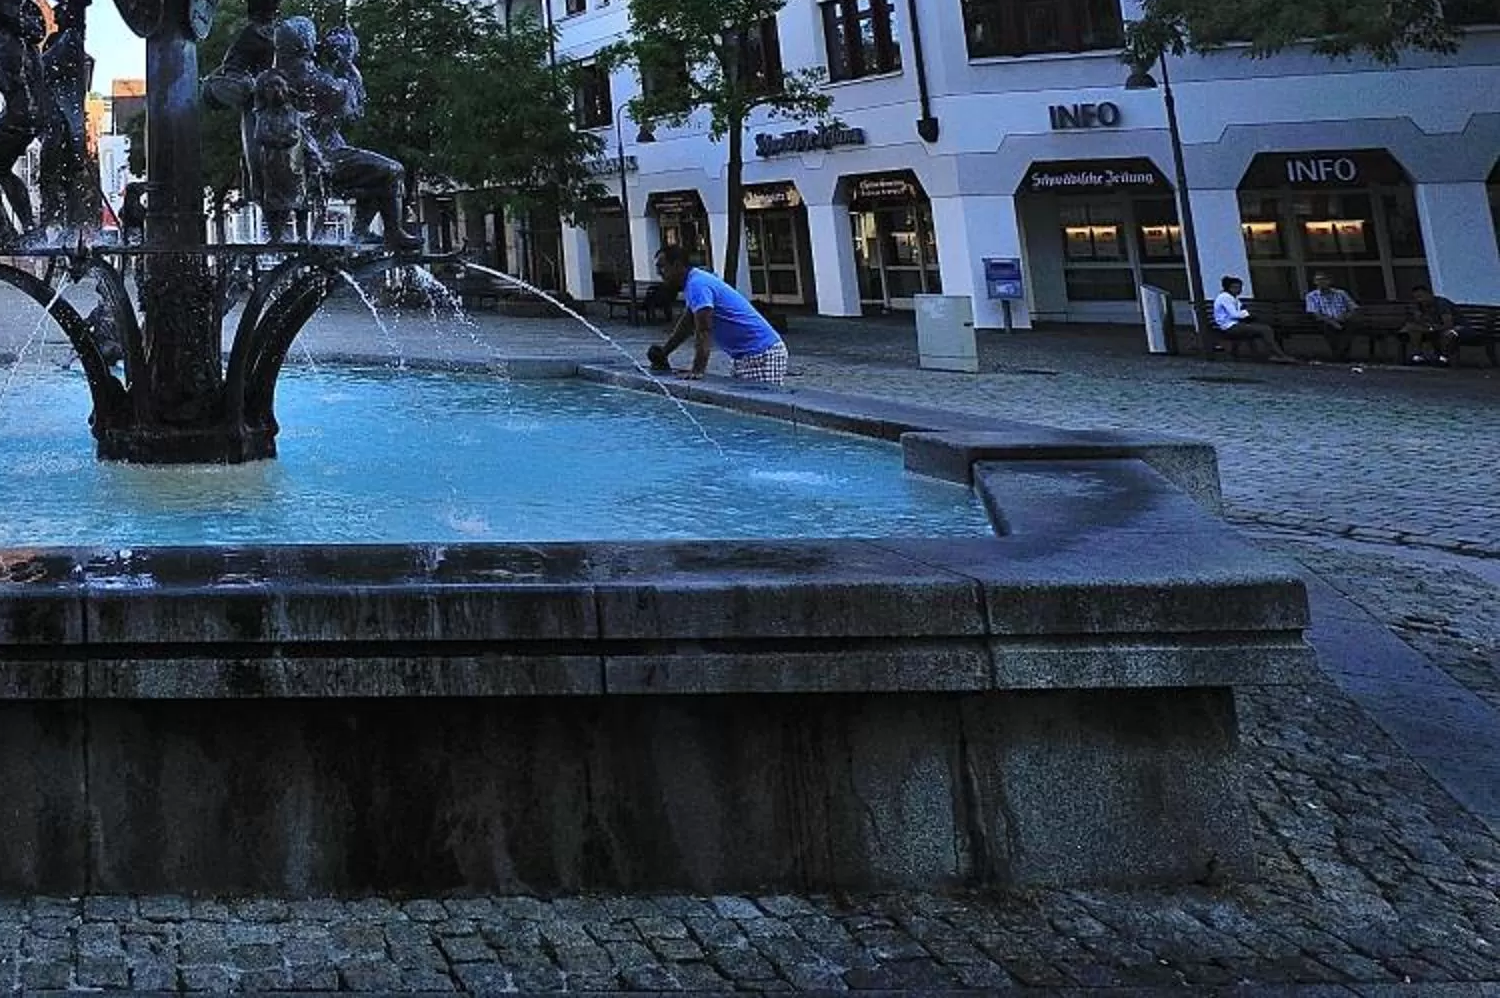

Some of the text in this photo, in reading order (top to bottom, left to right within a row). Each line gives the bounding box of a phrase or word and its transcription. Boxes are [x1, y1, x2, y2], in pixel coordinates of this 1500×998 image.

[1048, 102, 1121, 130] INFO
[1104, 169, 1155, 186] Zeitung
[1286, 157, 1357, 182] INFO
